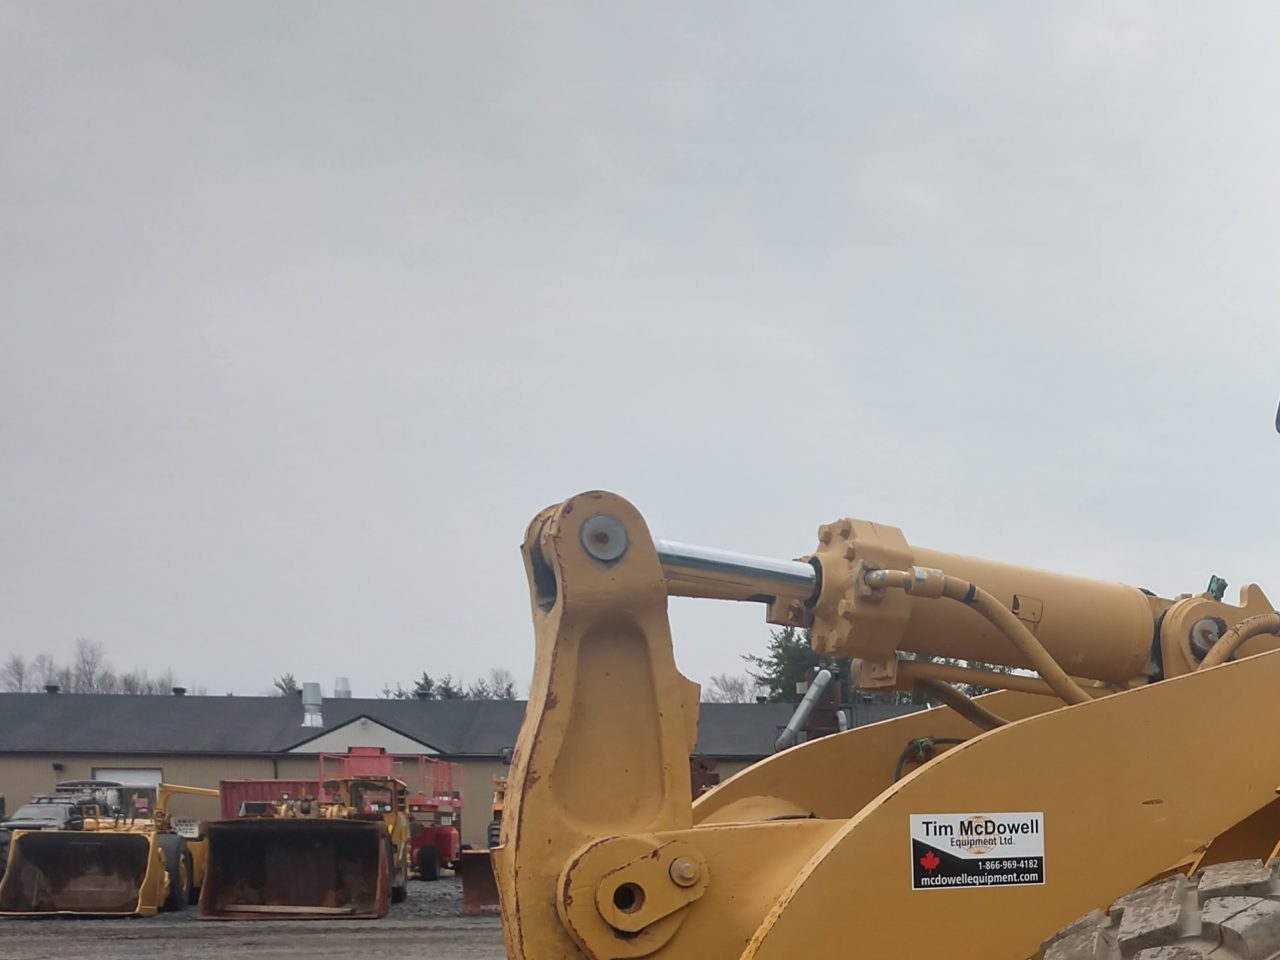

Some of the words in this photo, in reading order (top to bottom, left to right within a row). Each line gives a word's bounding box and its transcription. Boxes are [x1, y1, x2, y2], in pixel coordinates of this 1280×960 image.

[922, 821, 953, 837] Tim
[960, 819, 1039, 836] McDowell
[950, 837, 997, 849] Equipment
[999, 836, 1016, 846] Ltd.
[978, 859, 1039, 871] 1-866-969-4182
[921, 872, 1039, 887] mcdowellequipment.com
